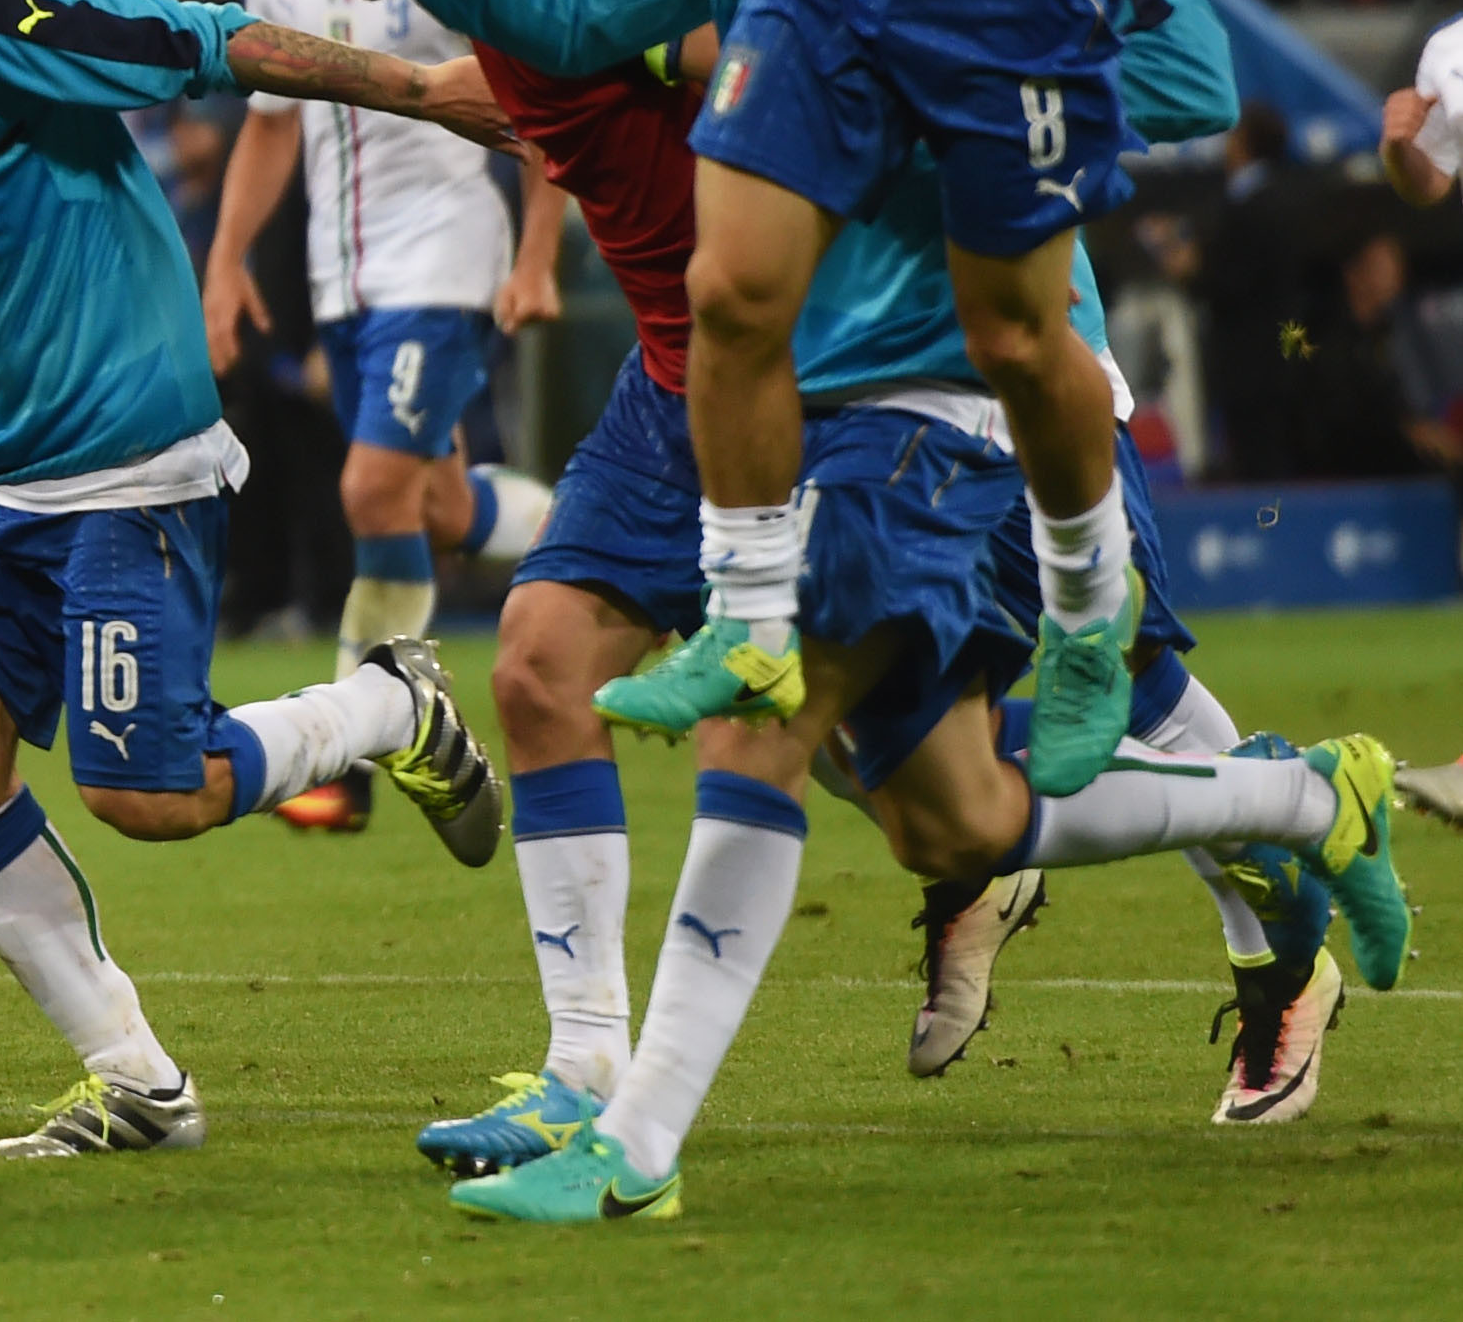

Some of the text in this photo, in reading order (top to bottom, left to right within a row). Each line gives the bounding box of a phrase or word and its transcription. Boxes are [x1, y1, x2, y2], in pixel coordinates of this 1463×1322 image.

[1019, 79, 1067, 170] 8
[387, 340, 425, 404] 9
[81, 620, 138, 712] 16
